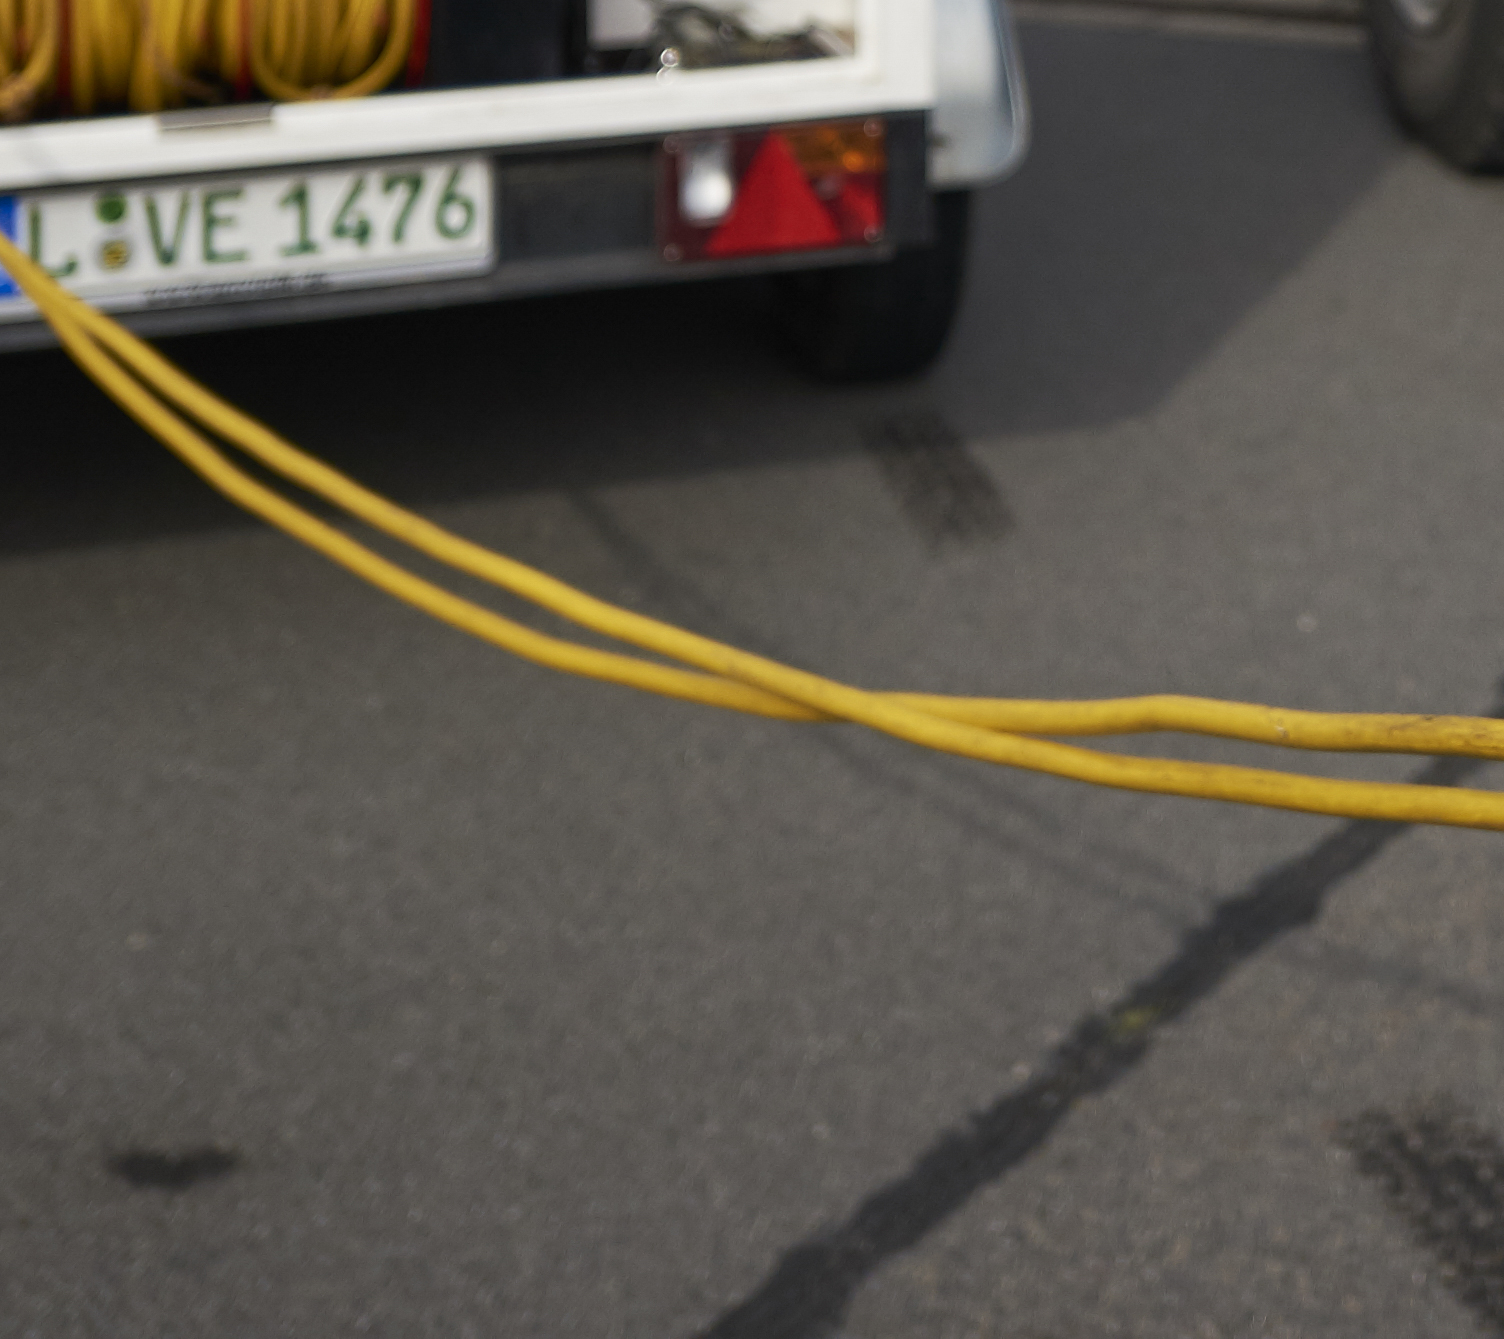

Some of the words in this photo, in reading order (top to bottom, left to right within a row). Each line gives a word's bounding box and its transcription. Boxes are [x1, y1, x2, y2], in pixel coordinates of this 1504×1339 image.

[28, 199, 78, 278] L
[144, 187, 250, 267] VE
[279, 165, 476, 255] 1476
